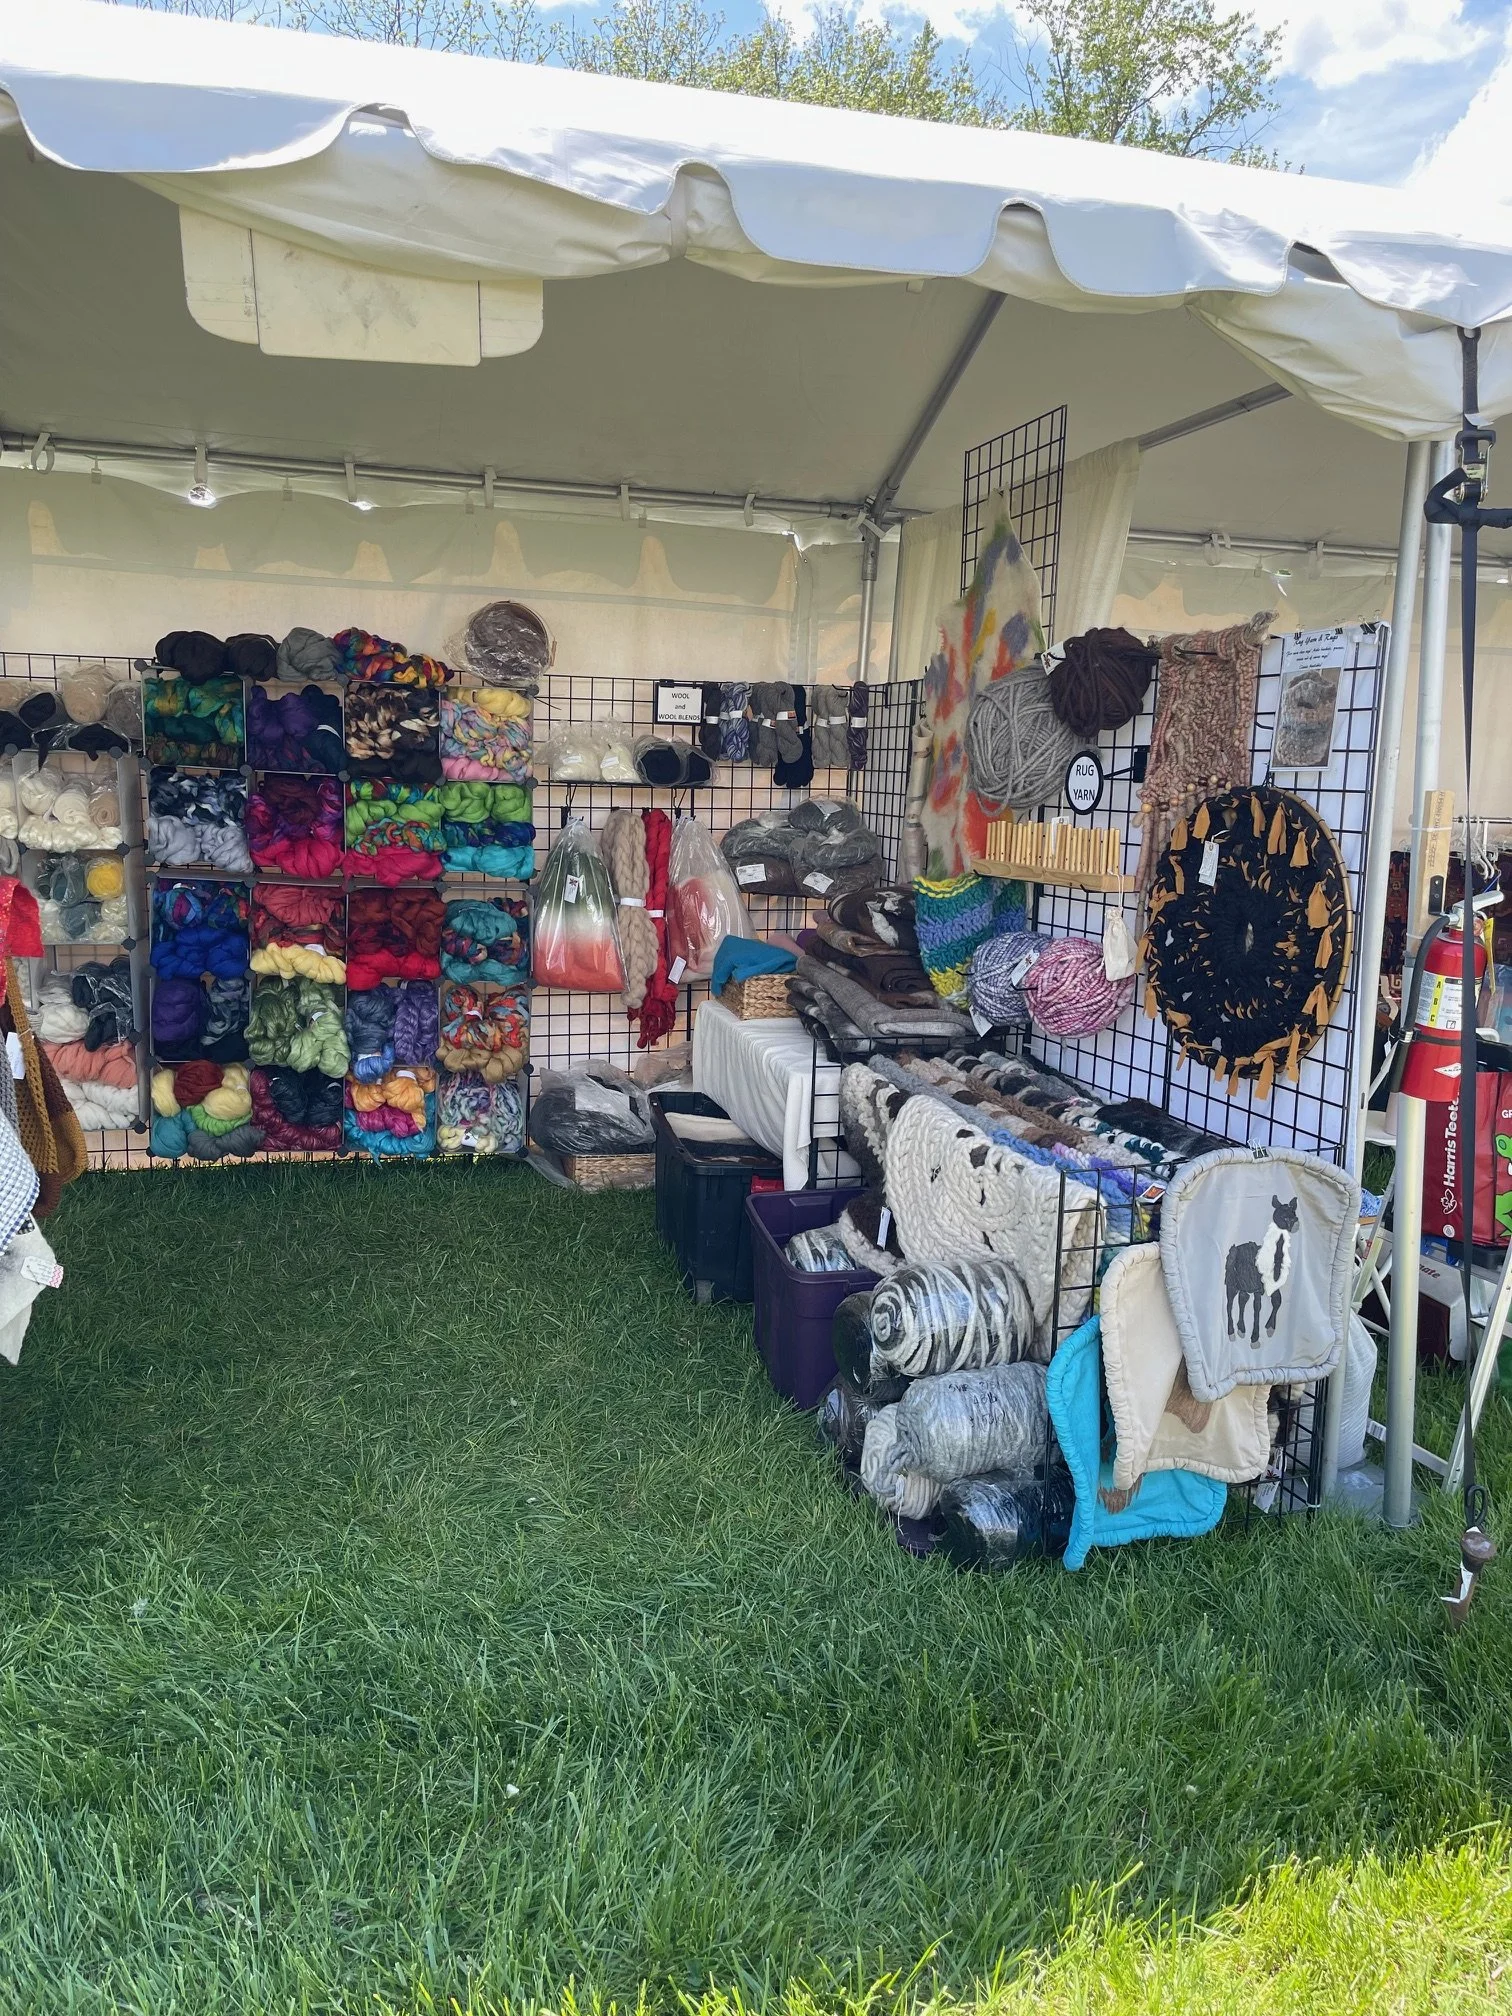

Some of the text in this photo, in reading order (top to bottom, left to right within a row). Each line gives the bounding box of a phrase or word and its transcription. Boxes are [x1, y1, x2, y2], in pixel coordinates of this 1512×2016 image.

[1076, 764, 1095, 777] RUG
[1073, 788, 1096, 801] YARN
[1436, 981, 1442, 989] A
[1430, 1014, 1436, 1022] C
[1443, 1091, 1460, 1188] Harris Teete
